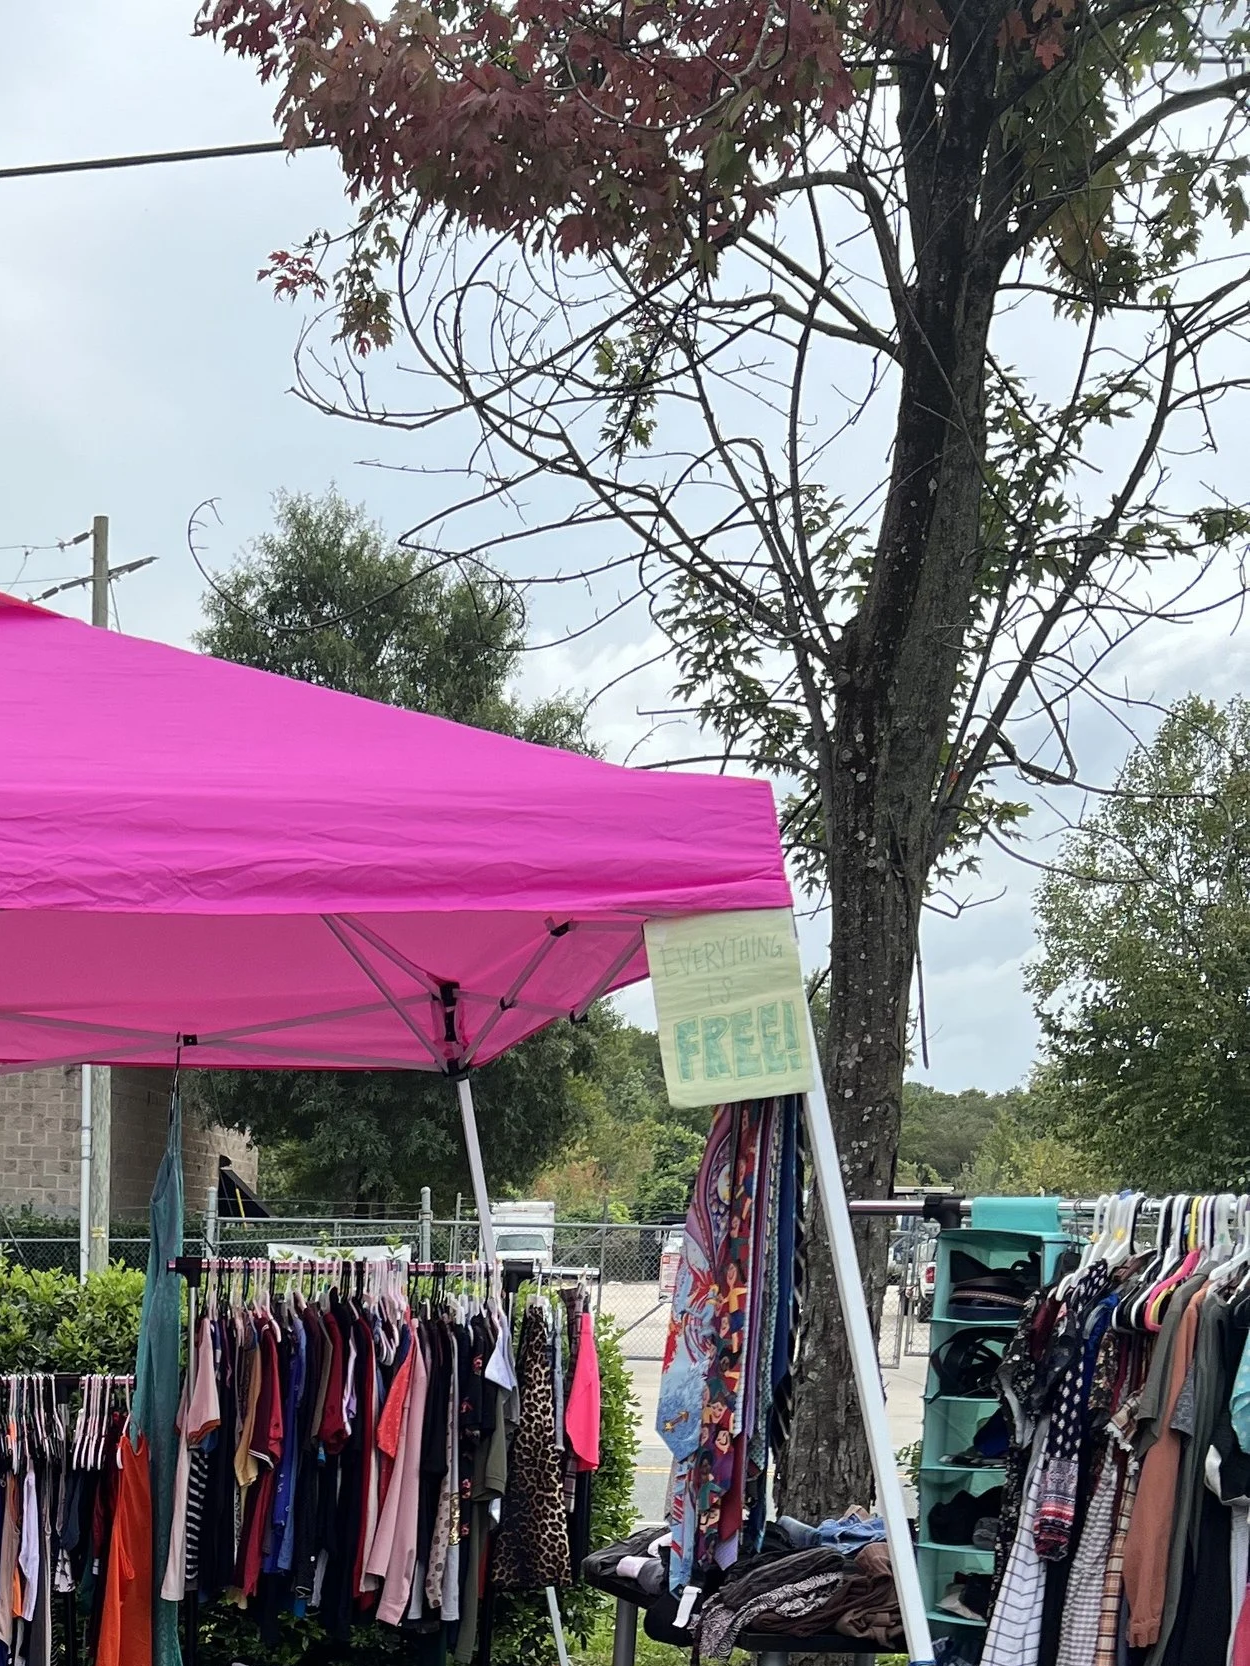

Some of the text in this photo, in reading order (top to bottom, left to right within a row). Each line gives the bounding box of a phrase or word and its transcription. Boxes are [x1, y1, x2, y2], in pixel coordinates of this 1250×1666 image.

[661, 934, 783, 977] EVERYTHING
[707, 976, 734, 1006] IS
[674, 1001, 802, 1083] FREE!
